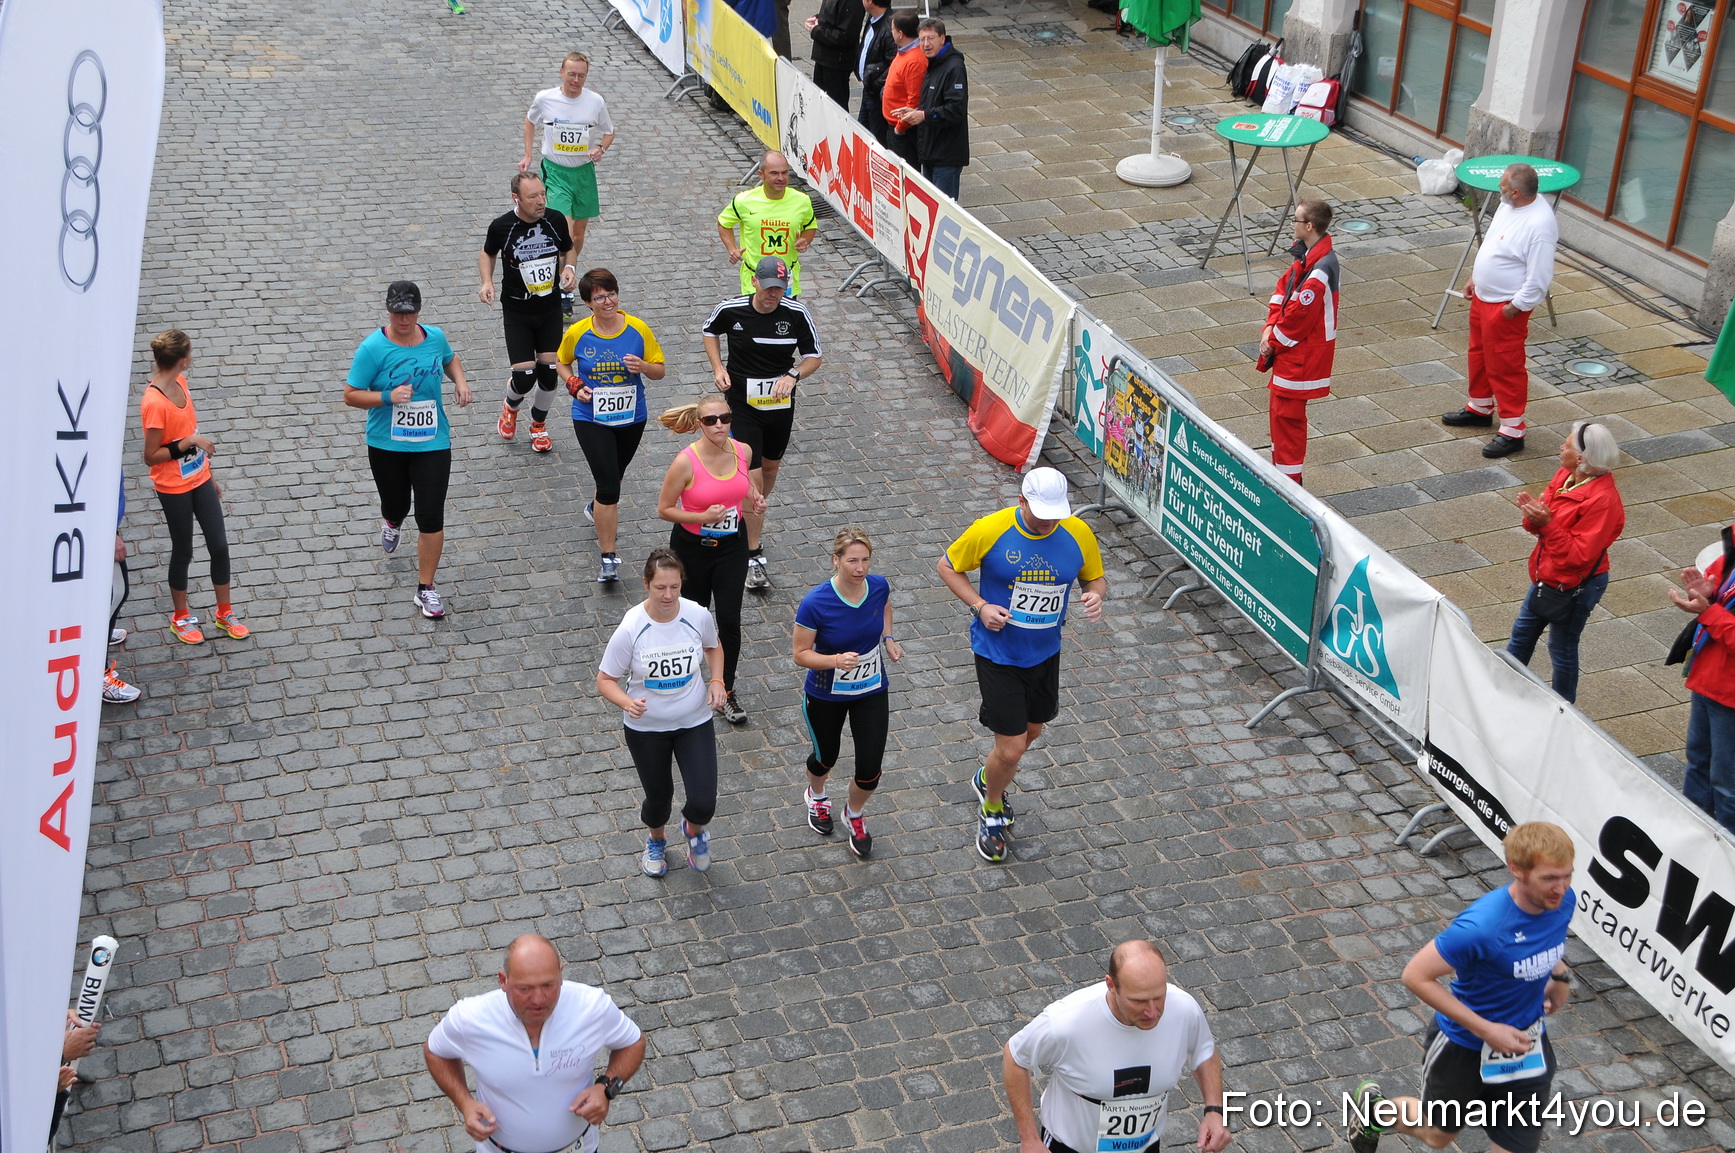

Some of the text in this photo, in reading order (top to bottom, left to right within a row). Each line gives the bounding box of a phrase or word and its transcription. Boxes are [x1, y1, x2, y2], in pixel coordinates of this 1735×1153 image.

[752, 97, 772, 129] KANN
[560, 131, 583, 144] 637
[851, 181, 872, 220] Braun
[761, 219, 791, 227] Müller
[767, 235, 783, 248] M
[529, 266, 553, 283] 183
[757, 381, 774, 396] 17
[598, 396, 633, 412] 2507
[396, 410, 434, 427] 2508
[605, 413, 625, 422] Sandra
[402, 429, 427, 437] Stefanie
[1192, 441, 1262, 508] Event-Leit-Systeme
[1170, 461, 1263, 557] Mehr Sicherheit
[1168, 487, 1244, 569] für Ihr Event!
[1166, 522, 1277, 632] Miet & Service Line: 09181 6352
[1015, 585, 1033, 593] PARTL
[1016, 594, 1060, 613] 2720
[39, 378, 91, 853] Audi BKK
[1025, 615, 1046, 623] David
[642, 648, 687, 660] PARTL Neumarkt
[648, 655, 693, 678] 2657
[657, 680, 687, 688] Annette
[1324, 652, 1354, 681] Gebäude
[1354, 672, 1379, 699] Service
[1379, 693, 1401, 716] GmbH
[1429, 754, 1476, 805] istungen,
[1477, 799, 1494, 819] die
[1577, 889, 1731, 1039] stadtwerke
[78, 976, 102, 1023] BMW
[1102, 1101, 1160, 1113] PARTL Neumarkt
[1106, 1105, 1162, 1136] 2077
